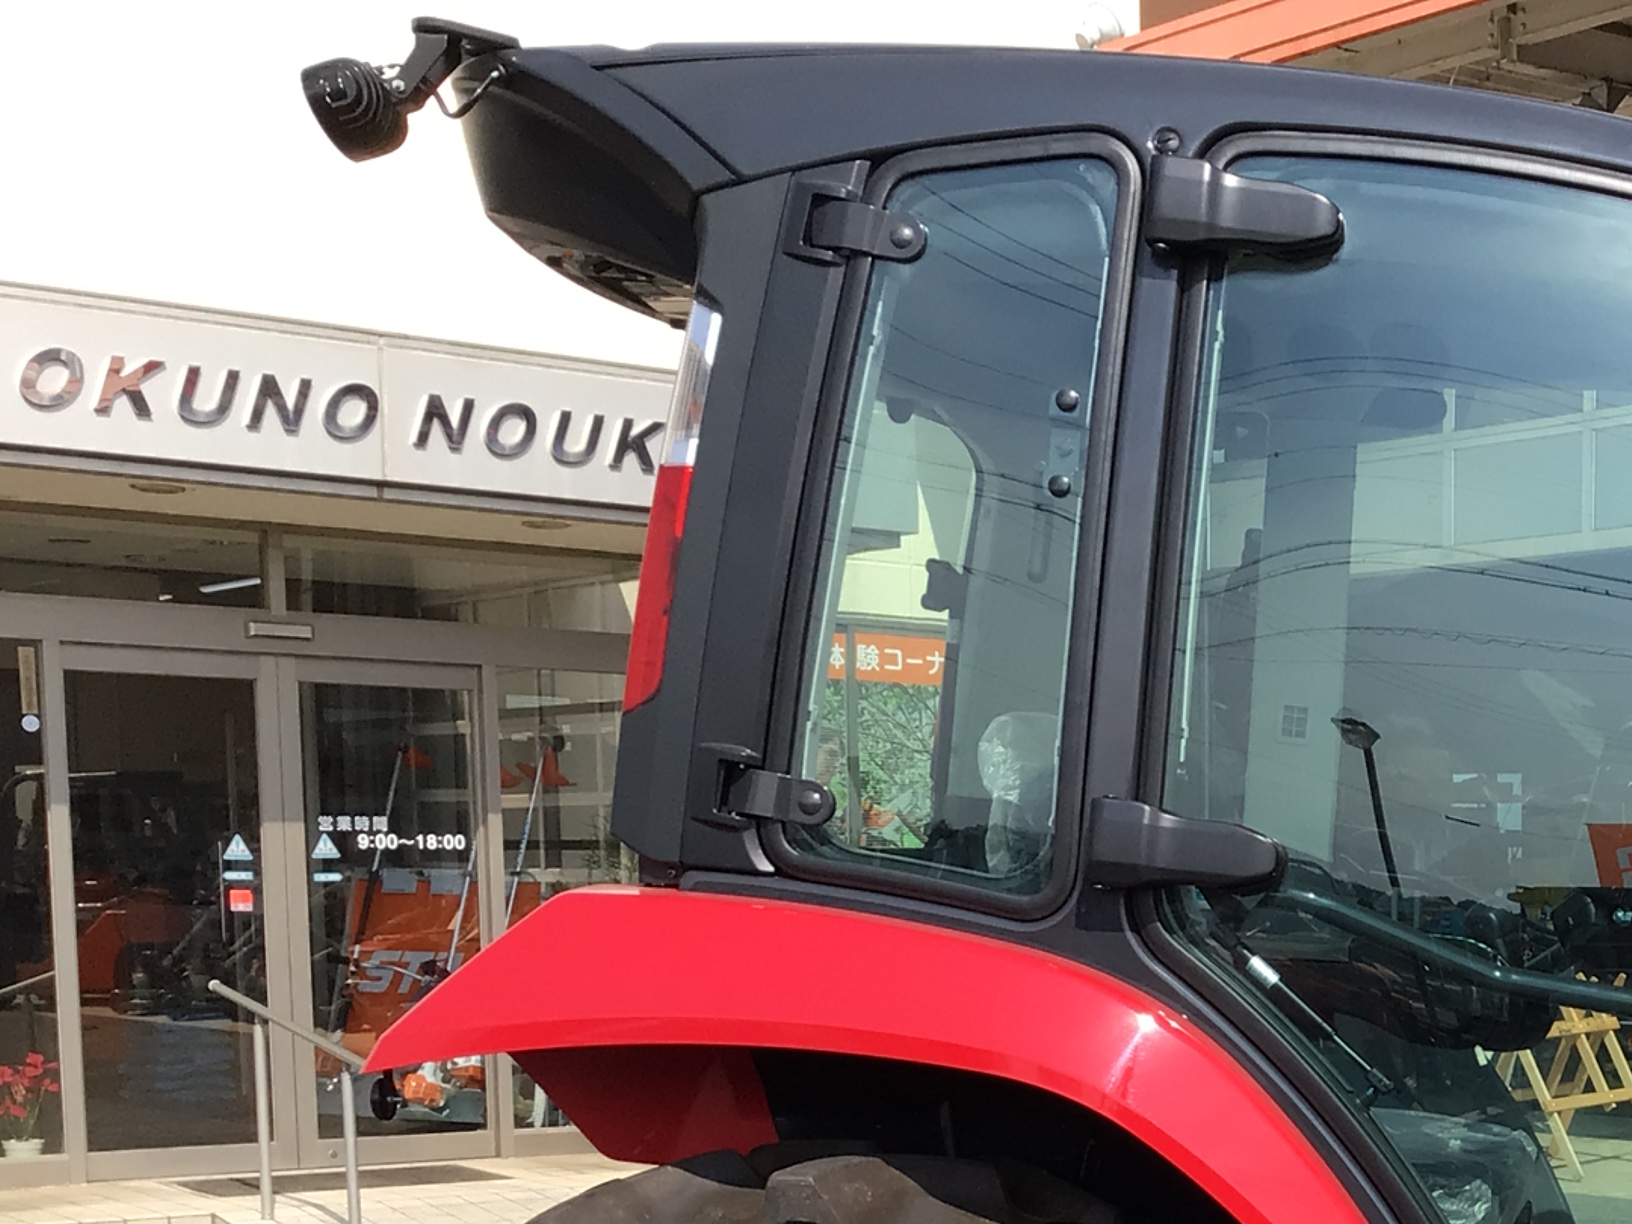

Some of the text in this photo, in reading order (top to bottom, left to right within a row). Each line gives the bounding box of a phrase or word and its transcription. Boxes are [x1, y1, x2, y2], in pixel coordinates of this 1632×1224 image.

[19, 346, 664, 475] OKUNO NOUK
[317, 815, 389, 832] 営業時間
